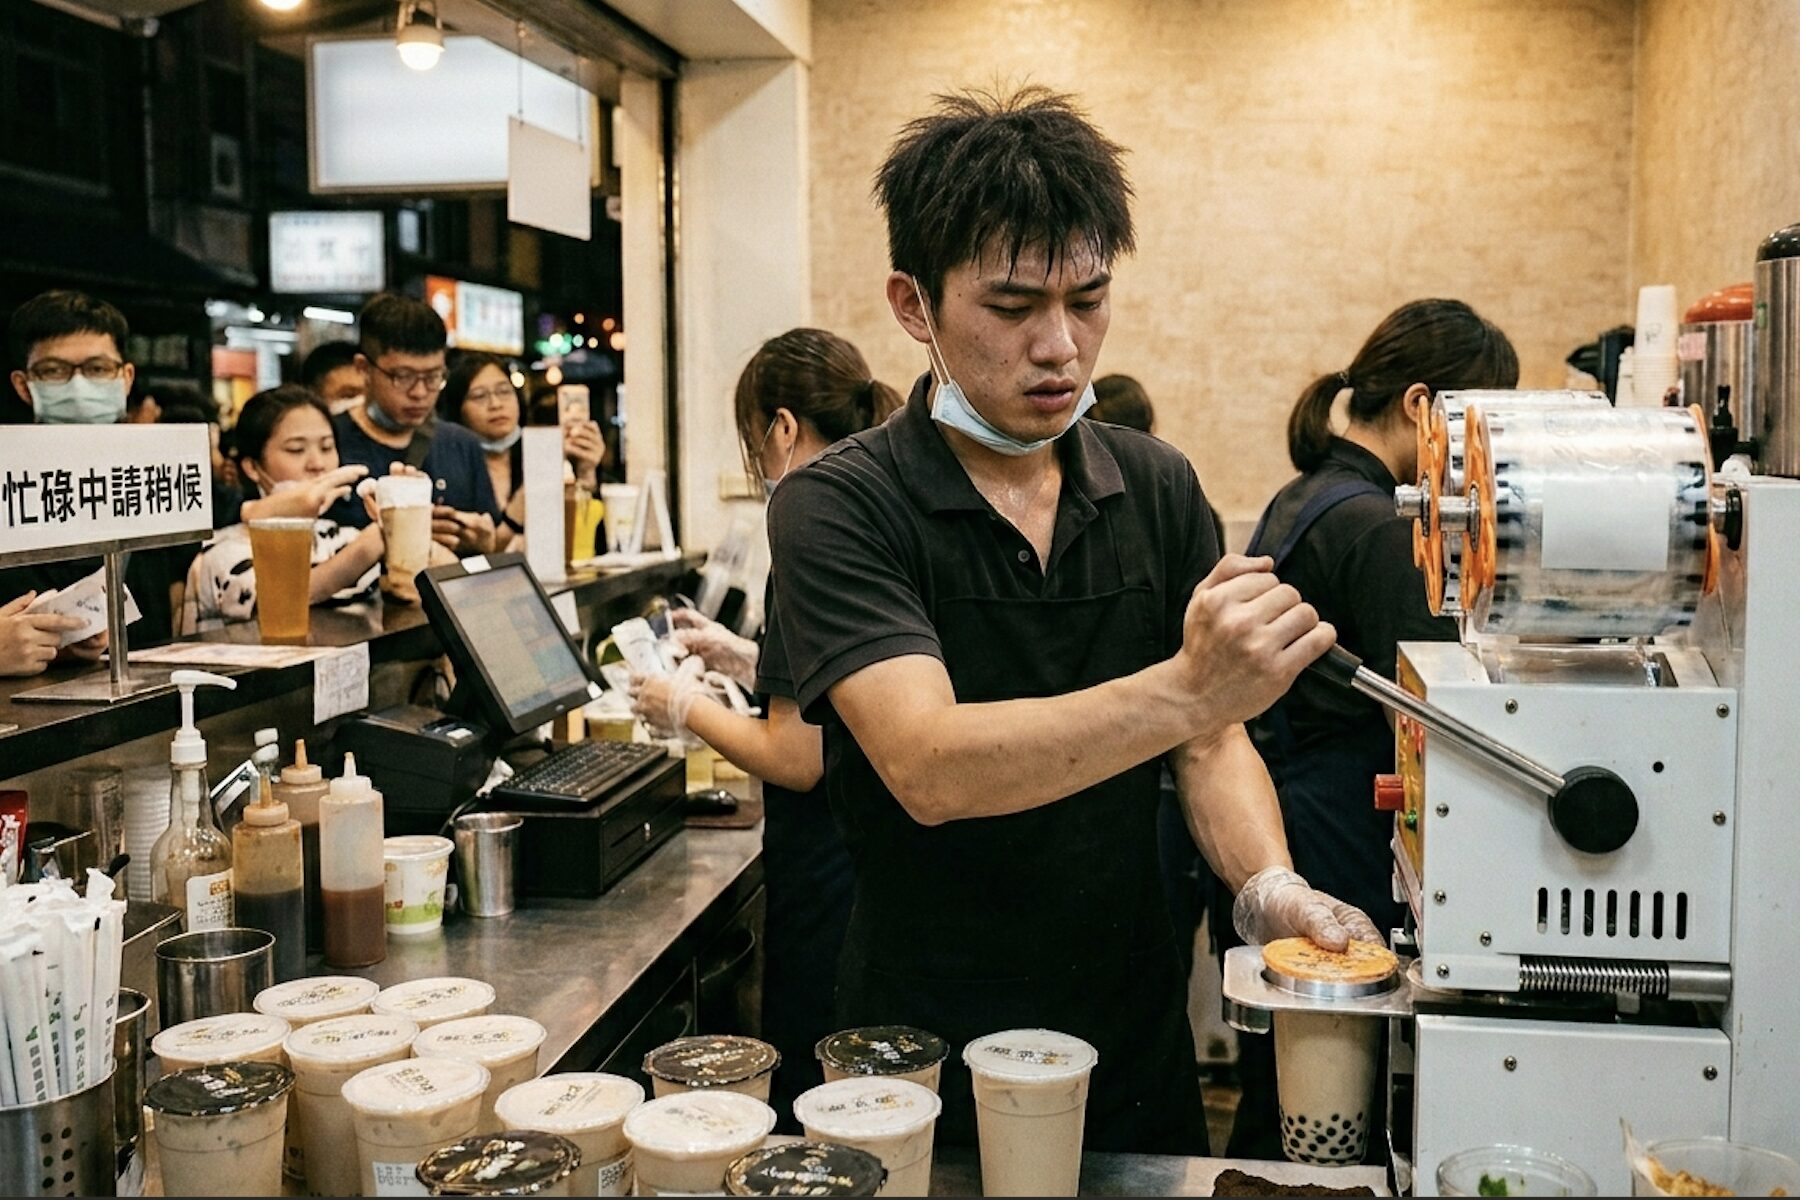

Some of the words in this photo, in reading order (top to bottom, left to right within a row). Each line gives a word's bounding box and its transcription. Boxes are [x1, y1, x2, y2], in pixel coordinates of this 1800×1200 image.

[2, 463, 203, 528] 忙碌中請稍候
